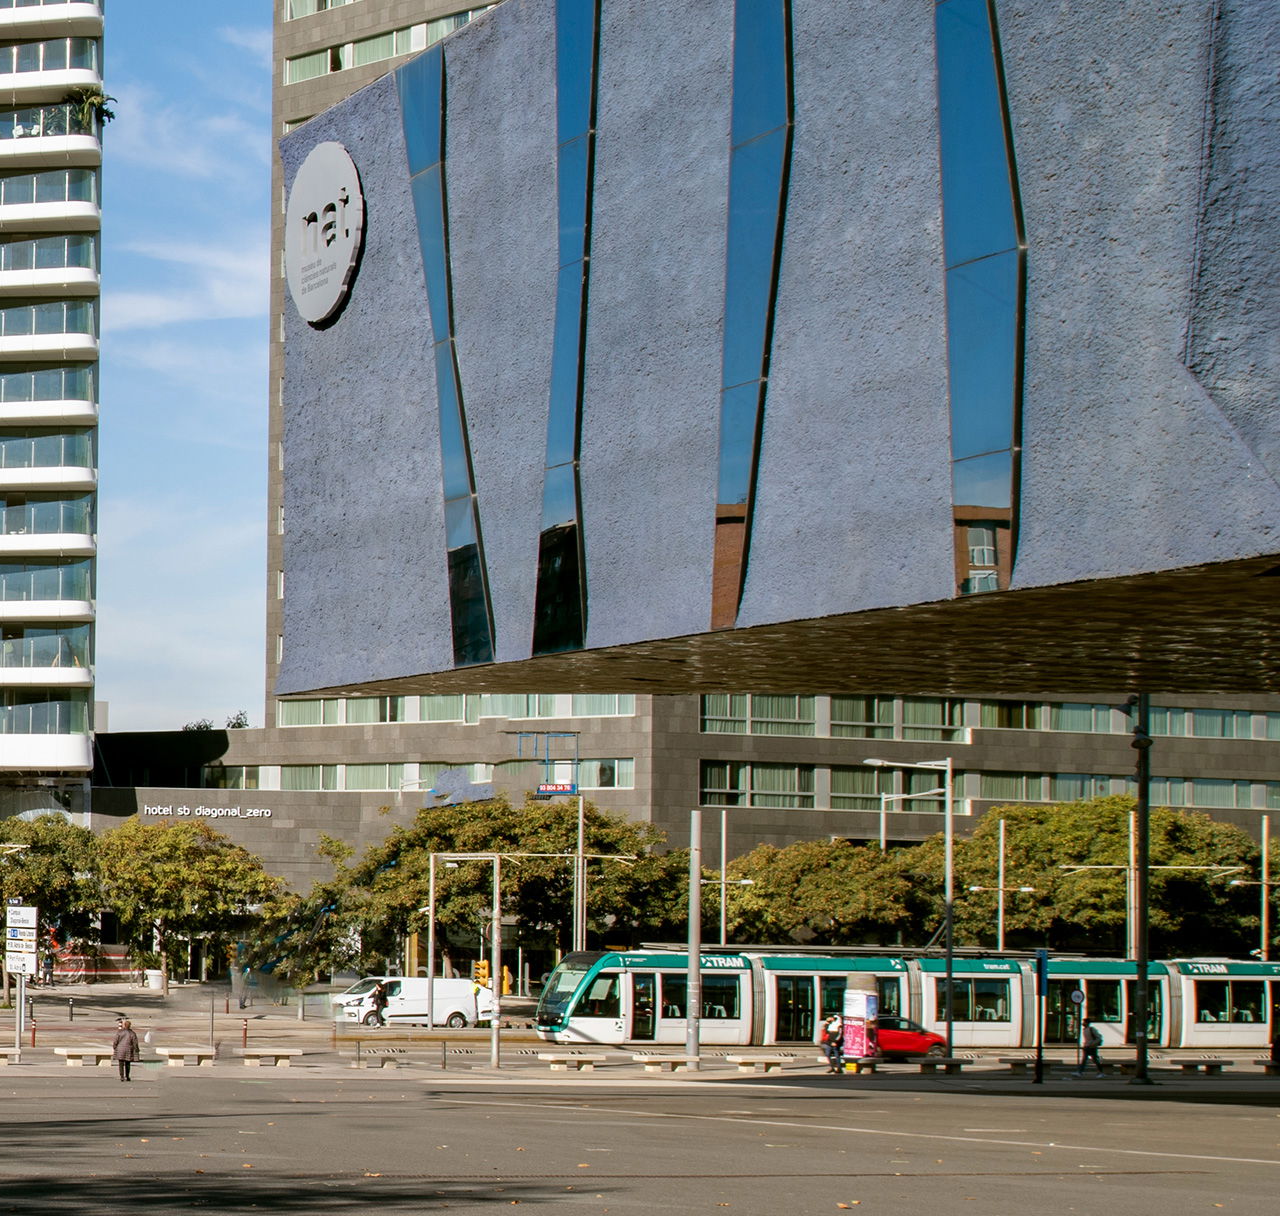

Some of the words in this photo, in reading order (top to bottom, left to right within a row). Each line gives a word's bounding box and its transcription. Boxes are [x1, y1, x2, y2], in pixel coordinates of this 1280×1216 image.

[144, 805, 173, 816] hotel
[177, 805, 192, 816] sb
[195, 806, 272, 819] diagonal_zero
[709, 956, 744, 967] TRAM
[1196, 963, 1228, 974] TRAM
